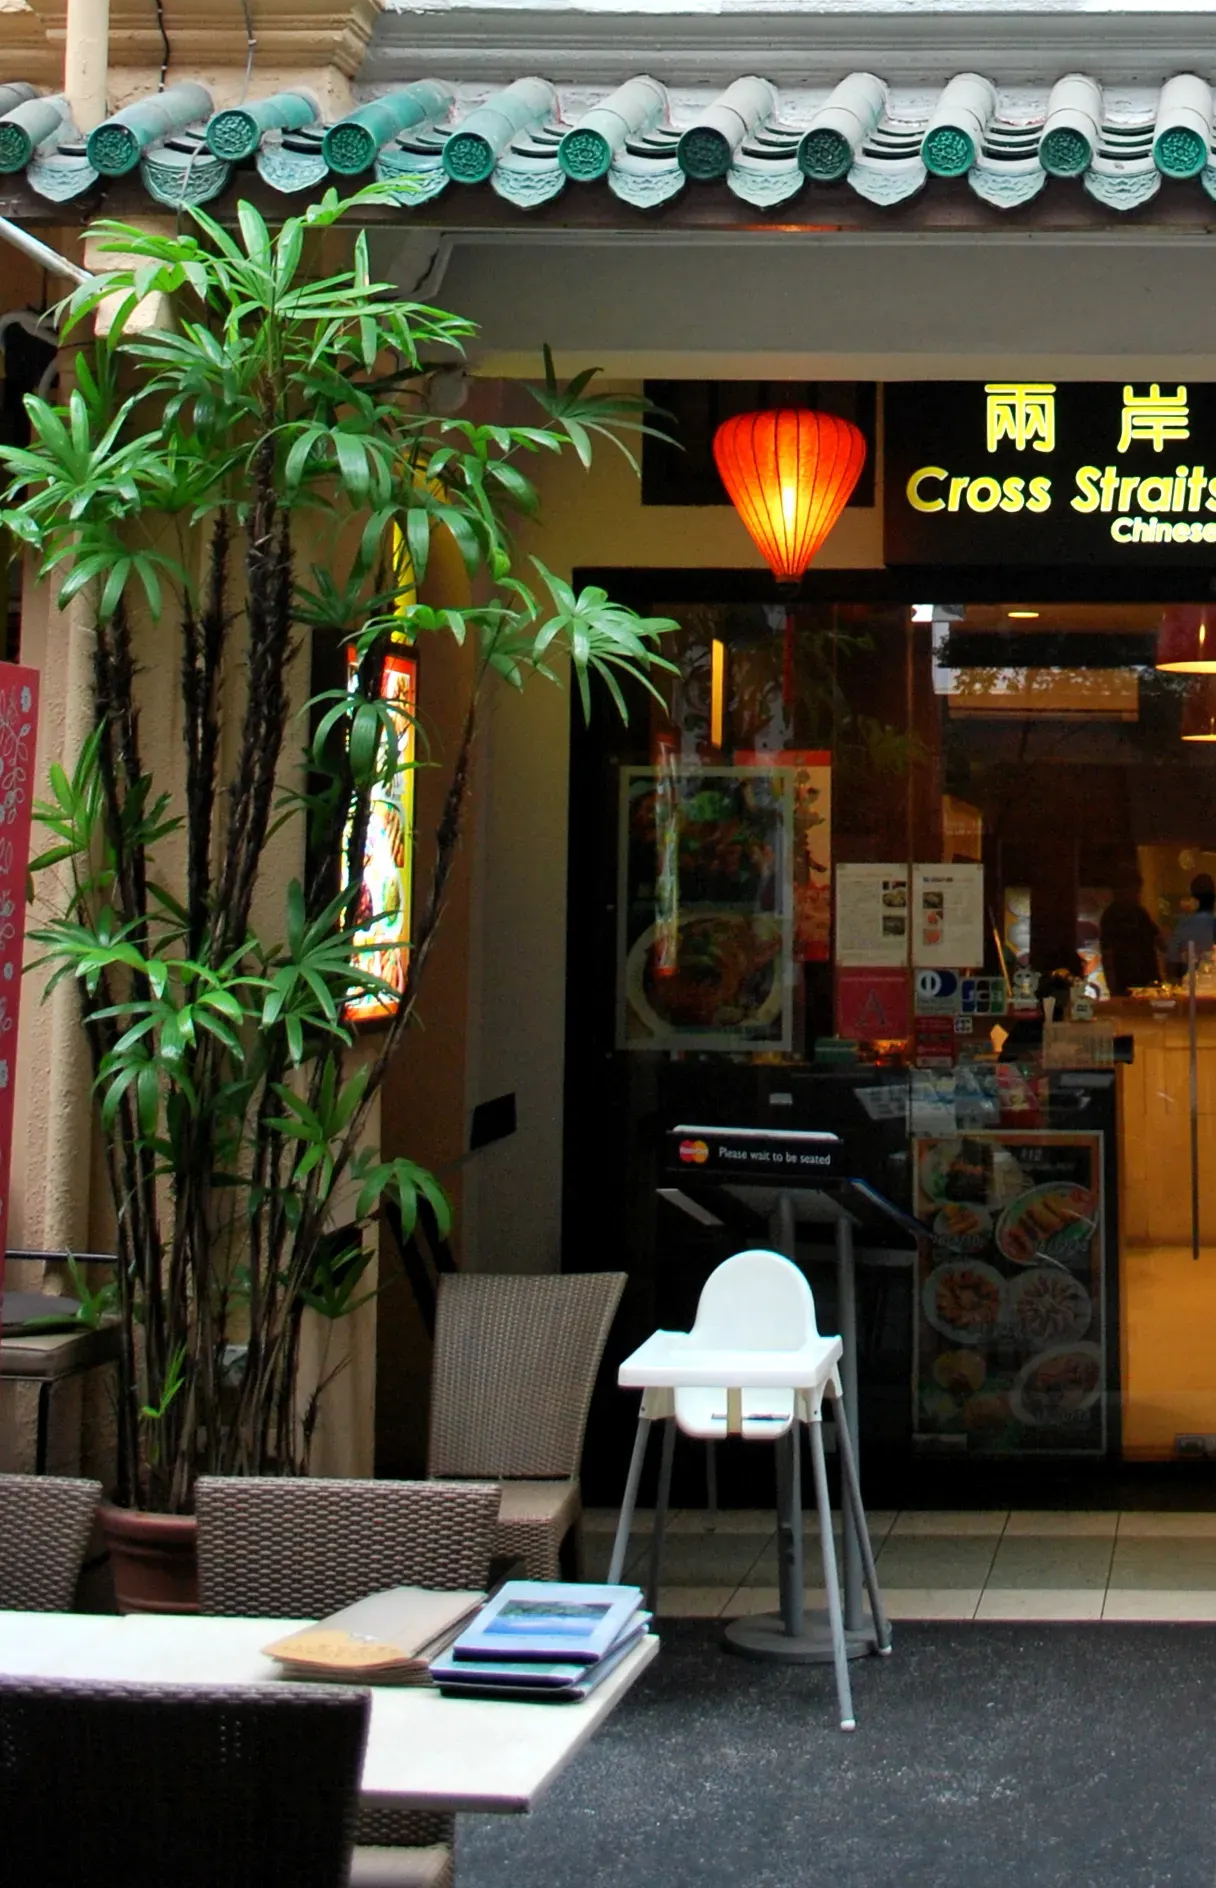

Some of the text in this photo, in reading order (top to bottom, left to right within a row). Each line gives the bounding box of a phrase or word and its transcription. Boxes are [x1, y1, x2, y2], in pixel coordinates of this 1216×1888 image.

[906, 465, 1051, 512] Cross
[718, 1146, 748, 1160] Please
[750, 1151, 770, 1161] wait
[772, 1152, 783, 1162] to
[786, 1151, 798, 1163] be
[800, 1153, 831, 1166] seated
